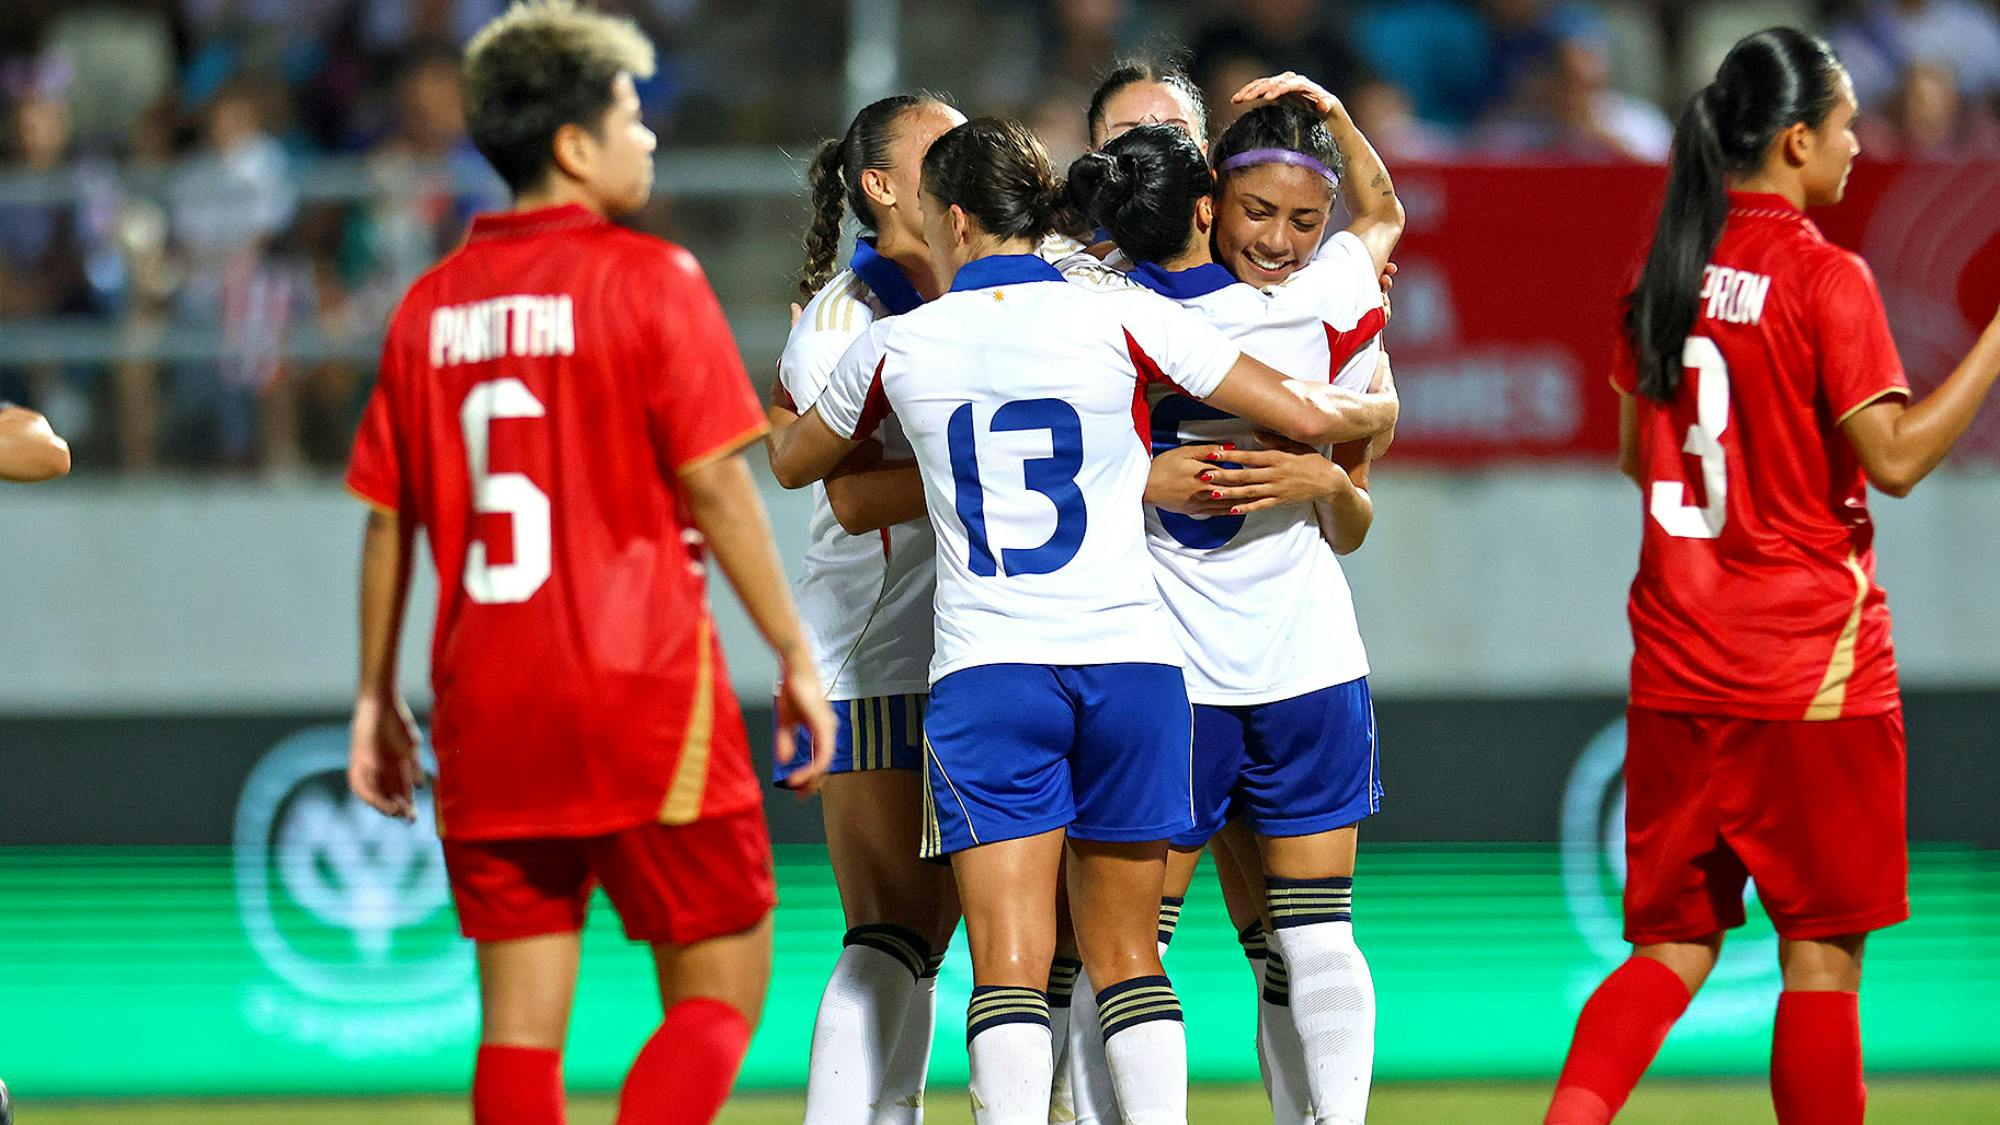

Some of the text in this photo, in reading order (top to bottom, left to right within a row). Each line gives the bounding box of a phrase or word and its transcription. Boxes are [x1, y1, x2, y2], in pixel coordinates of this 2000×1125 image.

[429, 293, 576, 369] PANITTHA
[1699, 264, 1771, 326] PRON
[459, 377, 552, 605] 5
[947, 397, 1087, 578] 13
[1650, 335, 1730, 539] 3
